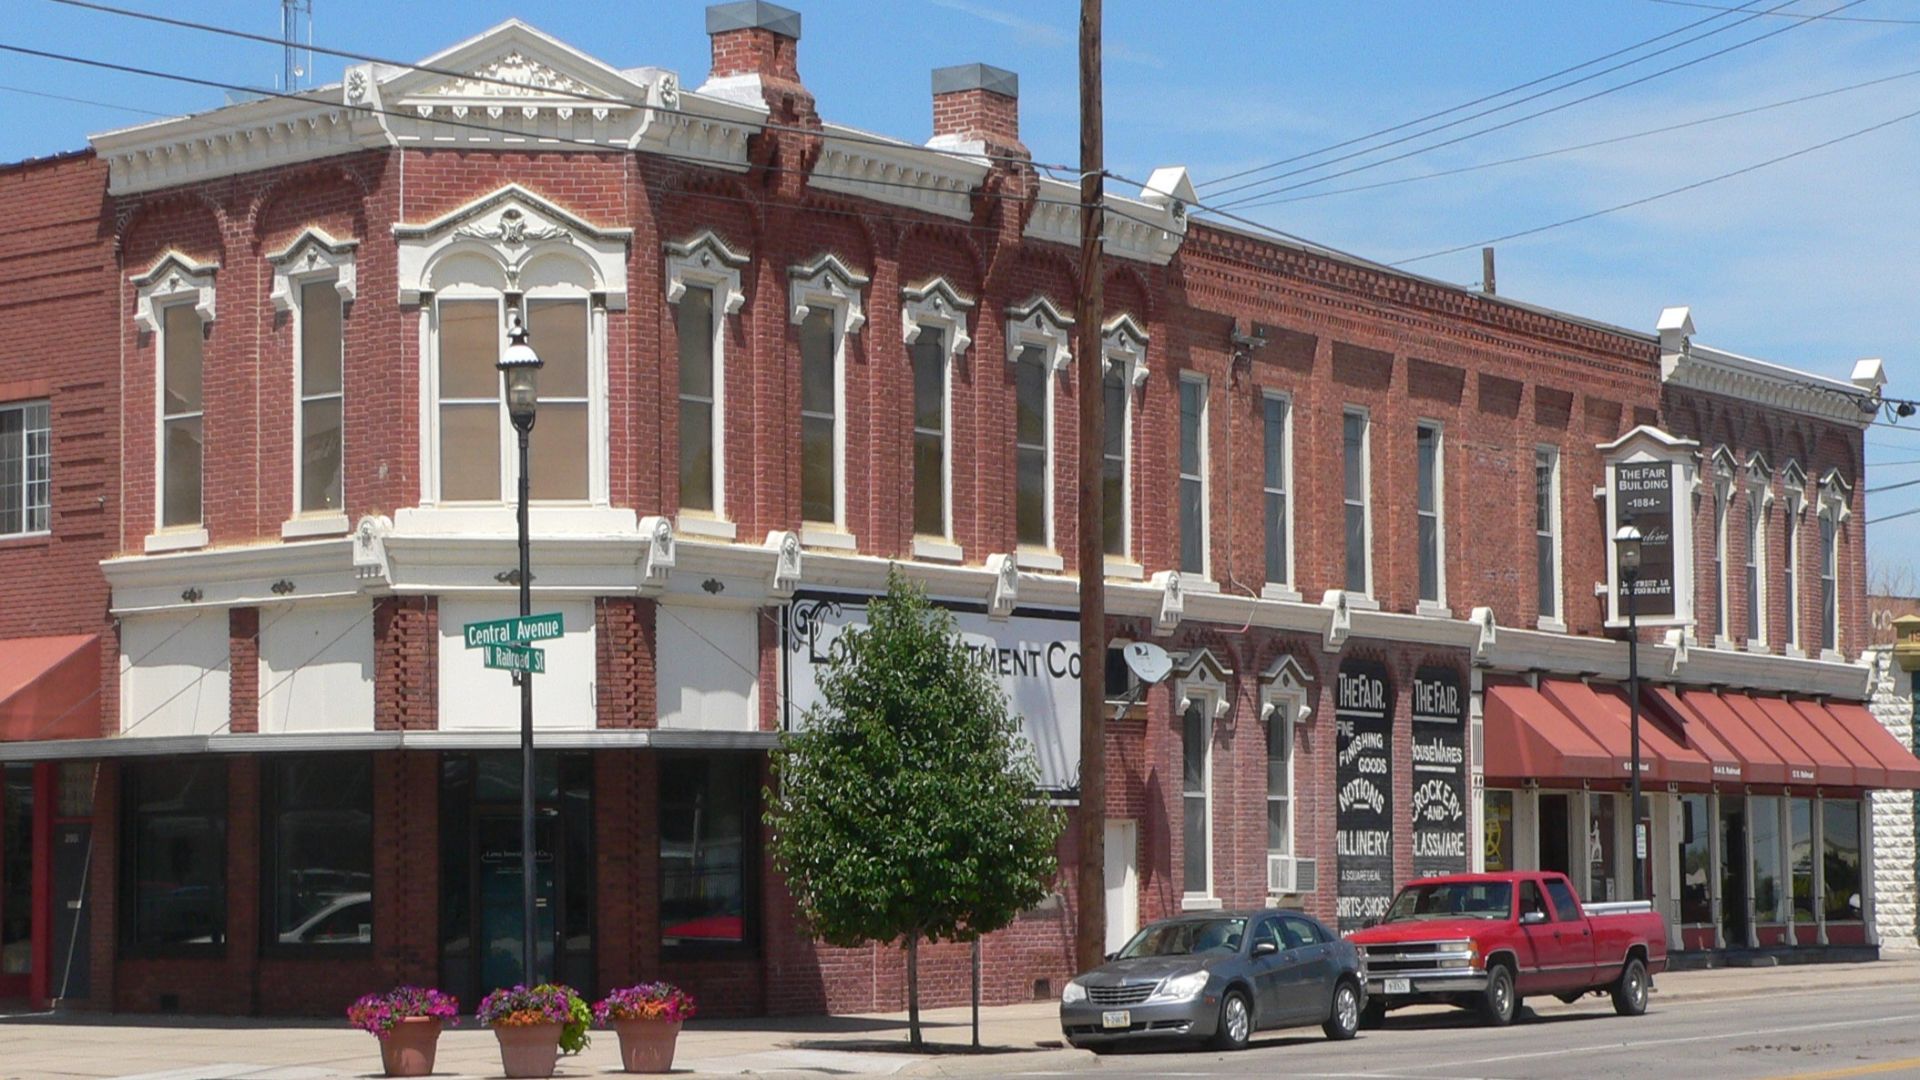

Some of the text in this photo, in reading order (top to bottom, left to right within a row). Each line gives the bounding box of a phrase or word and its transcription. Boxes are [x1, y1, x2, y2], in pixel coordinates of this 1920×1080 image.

[1619, 479, 1669, 491] BUILDING
[1620, 467, 1666, 480] THE FAIR
[468, 619, 559, 646] Central Avenue
[484, 646, 544, 670] N Railroad St
[1339, 731, 1383, 767] FINISHING
[1358, 757, 1387, 774] GOODS
[1339, 777, 1385, 814] NOTIONS
